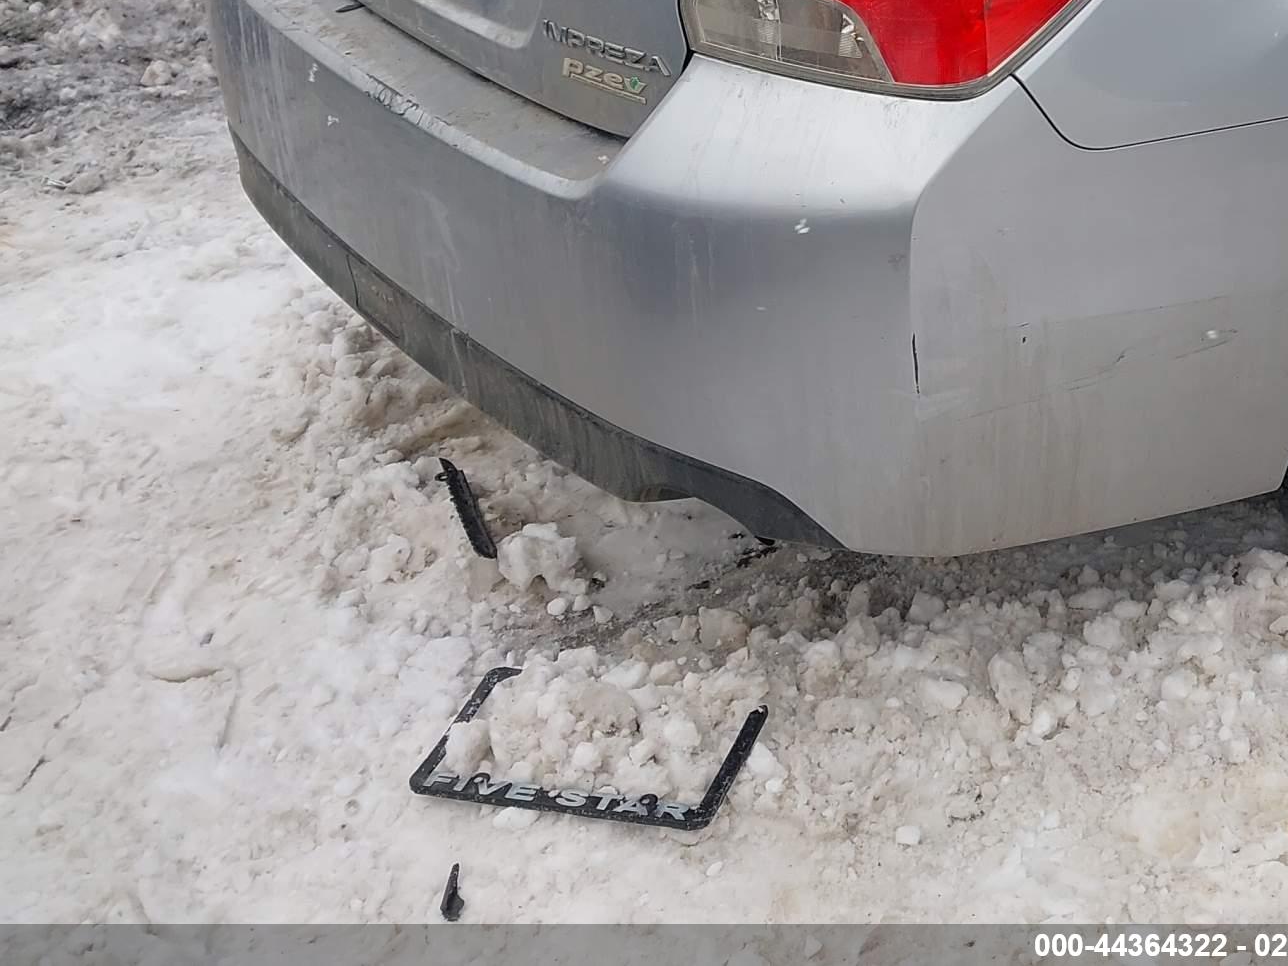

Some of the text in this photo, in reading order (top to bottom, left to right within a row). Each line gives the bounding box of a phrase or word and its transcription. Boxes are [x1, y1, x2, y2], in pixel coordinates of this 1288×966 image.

[542, 19, 672, 76] IMPREZA
[424, 772, 692, 821] FIVE STAR
